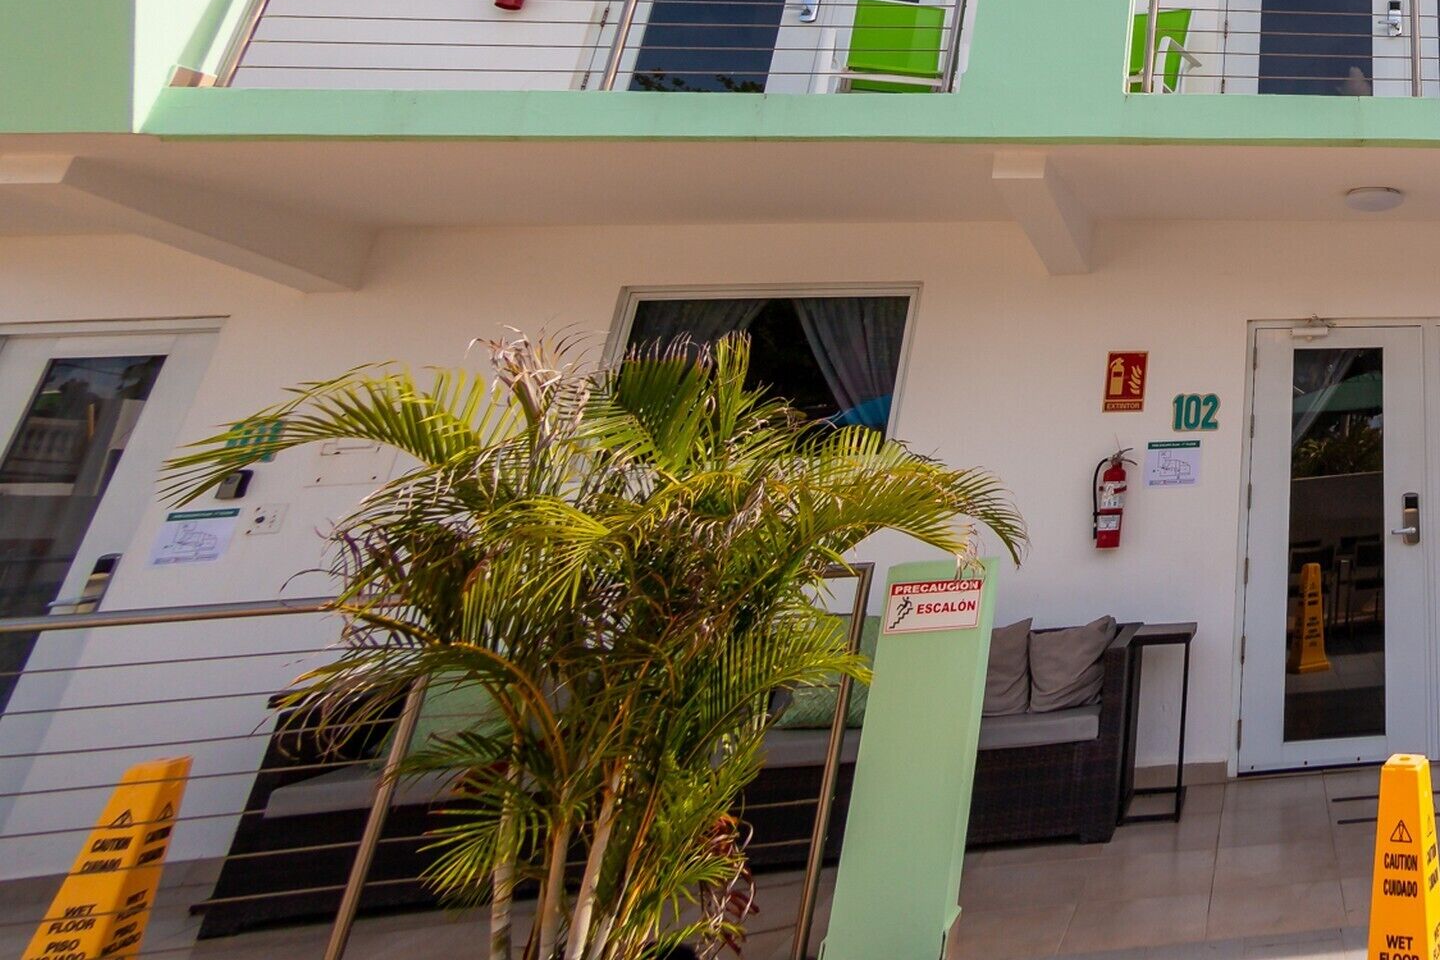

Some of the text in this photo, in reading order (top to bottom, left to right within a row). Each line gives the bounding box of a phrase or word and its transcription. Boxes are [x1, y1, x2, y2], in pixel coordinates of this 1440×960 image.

[1106, 401, 1140, 409] EXTINTOR
[1173, 394, 1219, 430] 102
[916, 599, 976, 614] ESCALÓN
[1383, 852, 1418, 871] CAUTION
[1383, 878, 1418, 898] CUIDADO
[64, 904, 97, 918] WET
[47, 918, 96, 935] FLOOR
[44, 938, 81, 955] PISO
[1386, 934, 1413, 950] WET
